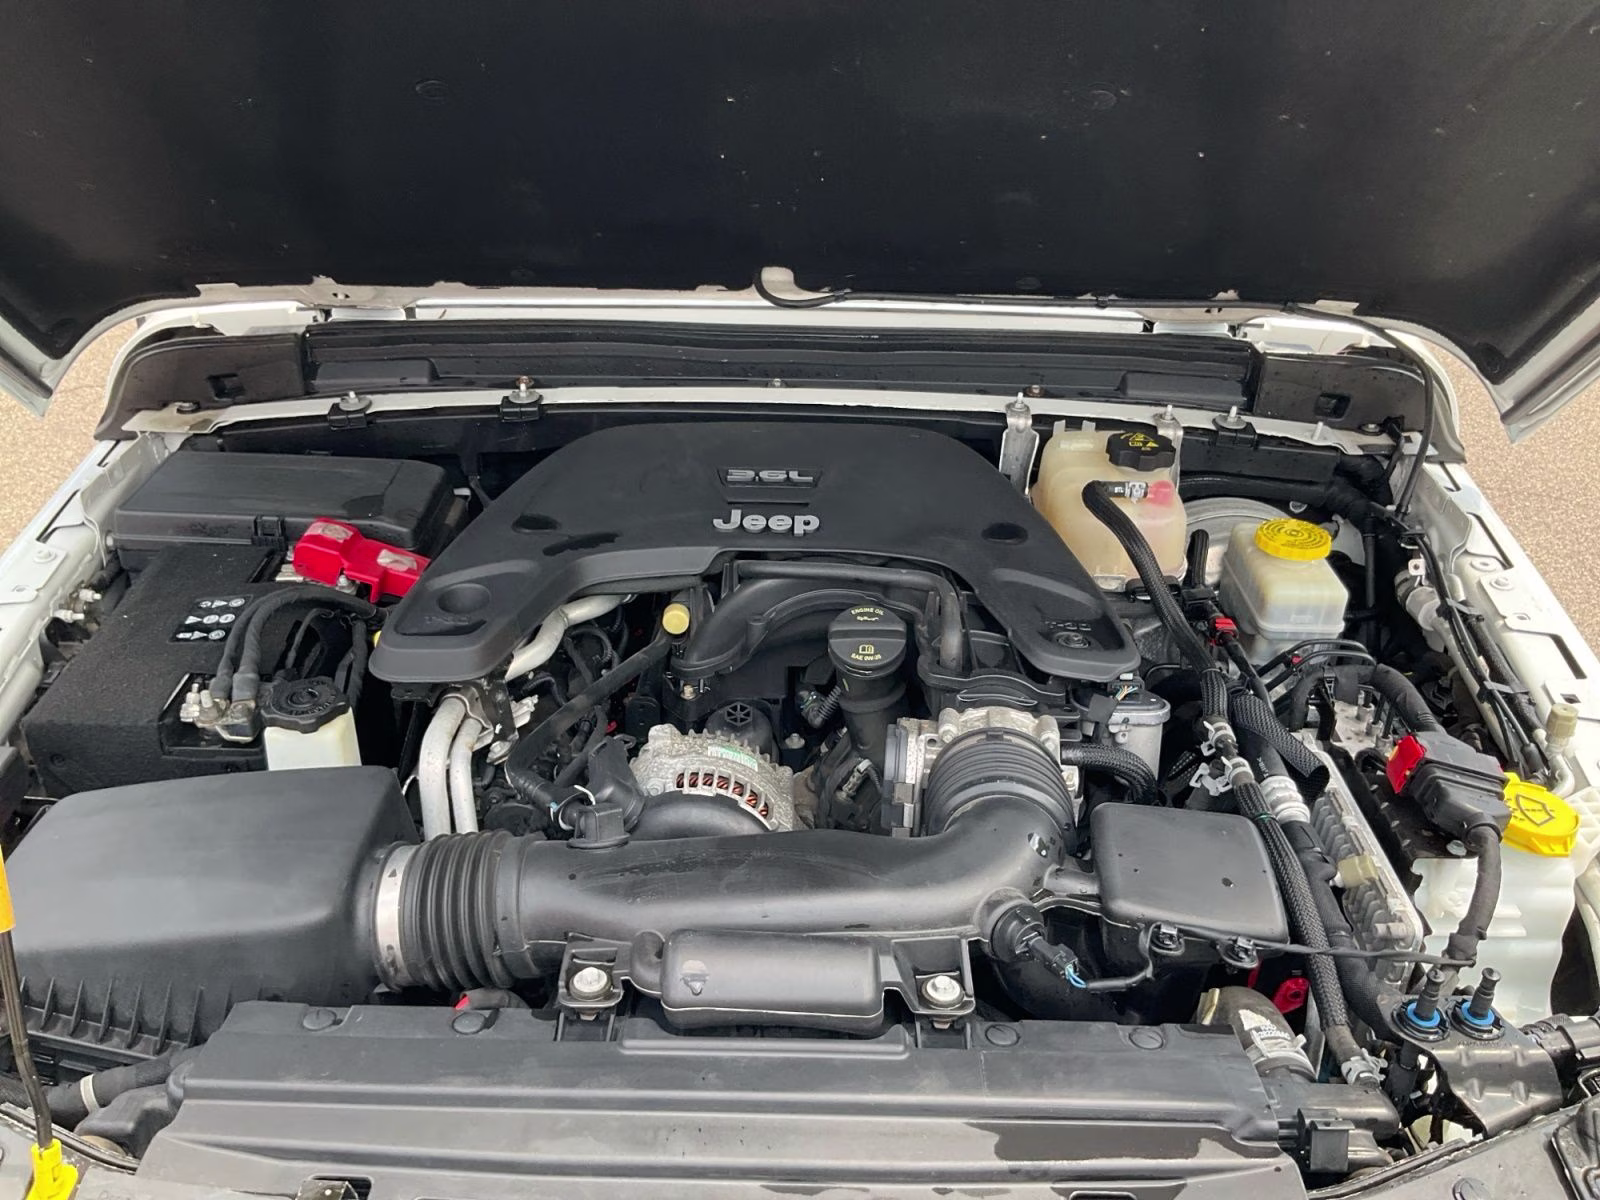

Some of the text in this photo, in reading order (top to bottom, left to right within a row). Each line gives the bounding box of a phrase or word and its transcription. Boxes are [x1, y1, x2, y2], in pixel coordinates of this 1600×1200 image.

[727, 469, 813, 482] 3.6L
[713, 509, 820, 536] Jeep
[851, 607, 874, 615] ENGINE
